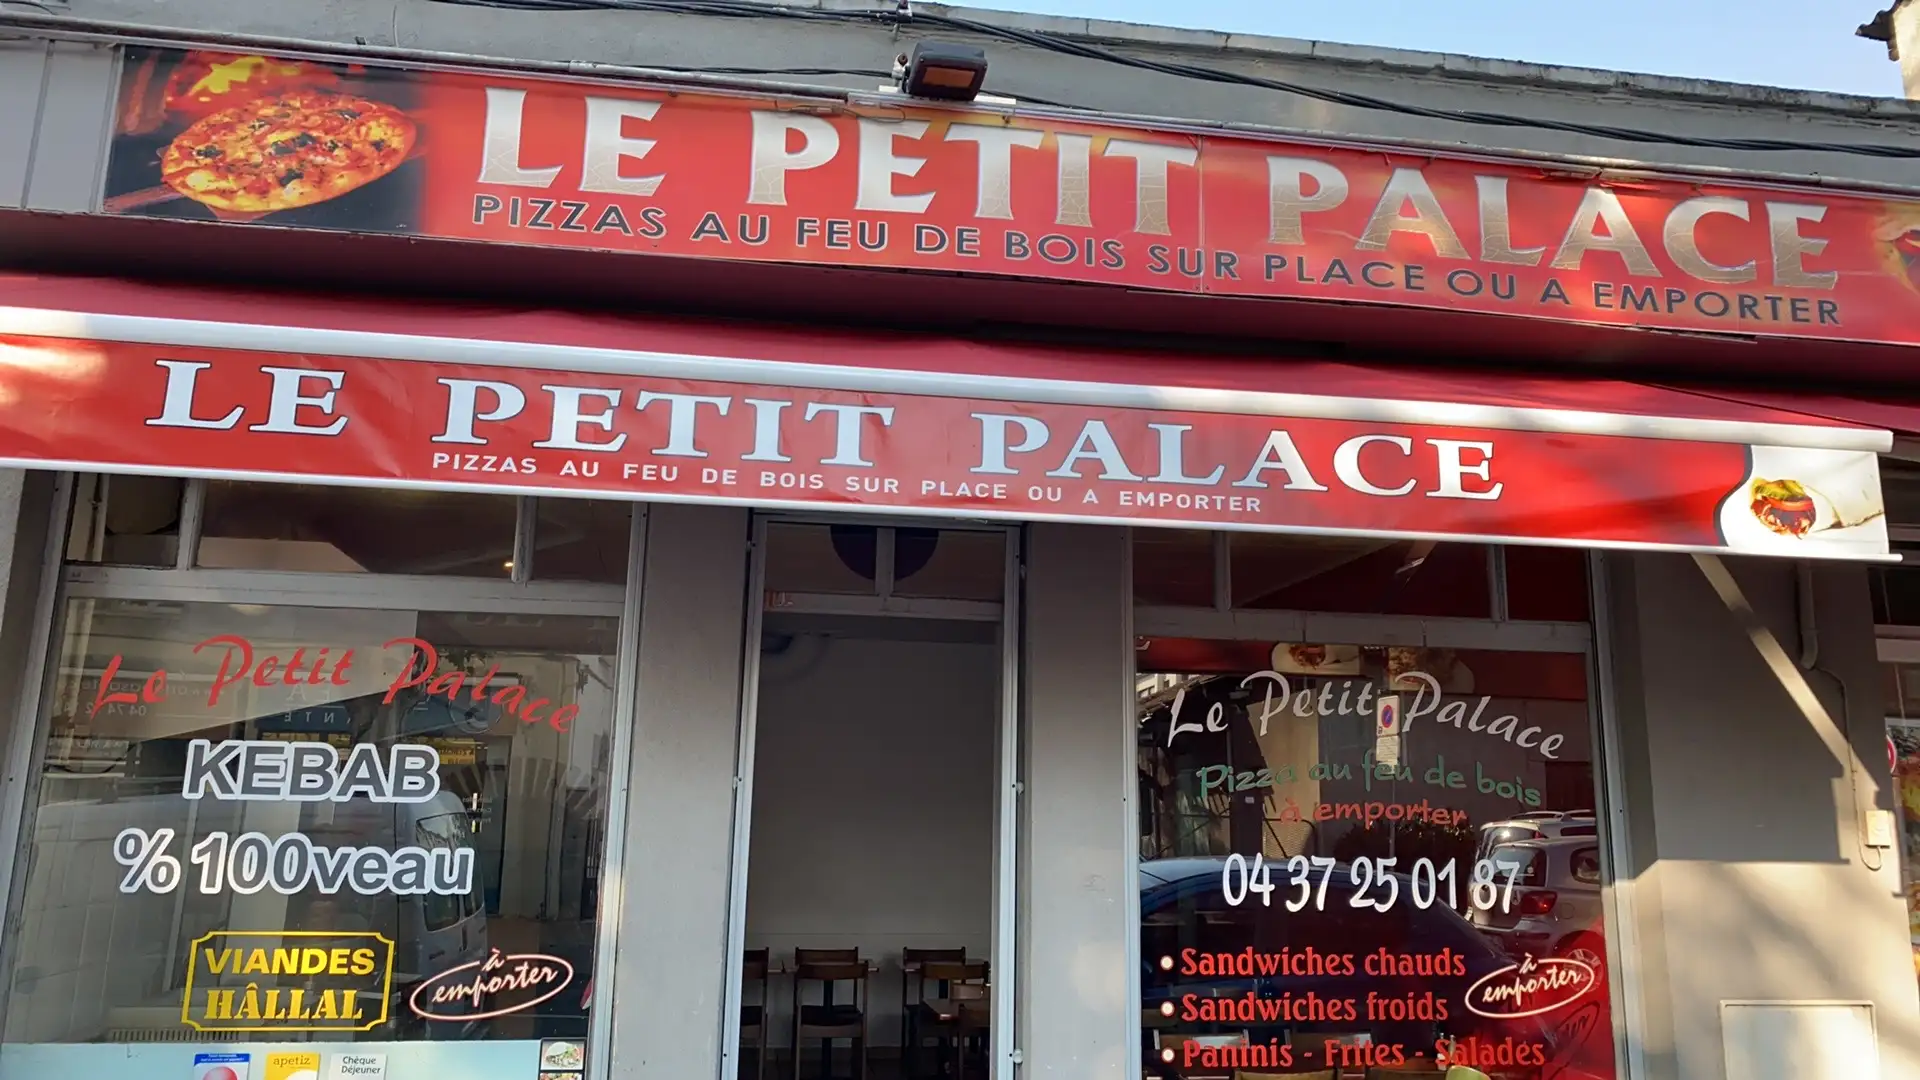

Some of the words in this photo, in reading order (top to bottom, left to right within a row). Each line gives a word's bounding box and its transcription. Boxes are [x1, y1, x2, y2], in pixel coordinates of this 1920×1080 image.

[476, 86, 667, 197] LE
[746, 108, 1199, 237] PETIT
[1266, 154, 1839, 291] PALACE
[472, 193, 667, 240] PIZZAS
[690, 211, 769, 246] AU
[795, 217, 888, 251] FEU
[914, 222, 980, 257] DE
[1003, 229, 1126, 271] BOIS
[1147, 244, 1240, 280] SUR
[1264, 253, 1427, 292] PLACE
[1447, 268, 1517, 300] OU
[1539, 276, 1571, 306] A
[1593, 281, 1841, 327] EMPORTER
[145, 359, 349, 436] LE
[430, 376, 894, 467] PETIT
[968, 411, 1504, 500] PALACE
[432, 452, 537, 474] PIZZAS
[560, 460, 599, 478] AU
[623, 462, 678, 482] FEU
[702, 467, 737, 486] DE
[760, 471, 824, 490] BOIS
[845, 475, 899, 495] SUR
[921, 479, 1007, 501] PLACE
[1028, 485, 1063, 503] OU
[1082, 488, 1099, 505] A
[1119, 490, 1262, 513] EMPORTER
[90, 654, 166, 720] Le
[193, 634, 353, 708] Petit
[383, 637, 581, 733] Palace
[1167, 687, 1229, 748] Le
[1239, 670, 1373, 737] Petit
[1395, 671, 1565, 759] Palace
[182, 739, 441, 803] KEBAB
[1197, 764, 1297, 799] Pizza
[1309, 763, 1351, 783] au
[1361, 750, 1414, 791] feu
[1423, 755, 1467, 788] de
[1475, 764, 1542, 806] bois
[1313, 800, 1468, 830] emporter
[1222, 853, 1275, 906] 04
[1285, 854, 1336, 912] 37
[1350, 857, 1400, 913] 25
[1411, 857, 1459, 911] 01
[1472, 860, 1521, 914] 87
[205, 947, 376, 976] VIANDES
[481, 948, 506, 972] à
[1181, 947, 1355, 977] Sandwiches
[1363, 947, 1466, 976] chauds
[1518, 952, 1540, 975] à
[204, 984, 364, 1020] HÂLLAL
[431, 964, 560, 1006] emporter
[1482, 964, 1582, 1006] emporter
[1181, 992, 1357, 1022] Sandwiches
[1366, 992, 1448, 1022] froids
[273, 1055, 311, 1068] apetiz
[341, 1065, 381, 1076] Déjeuner
[1183, 1038, 1294, 1067] Paninis
[1324, 1038, 1405, 1067] Frites
[1435, 1037, 1545, 1067] Salades
